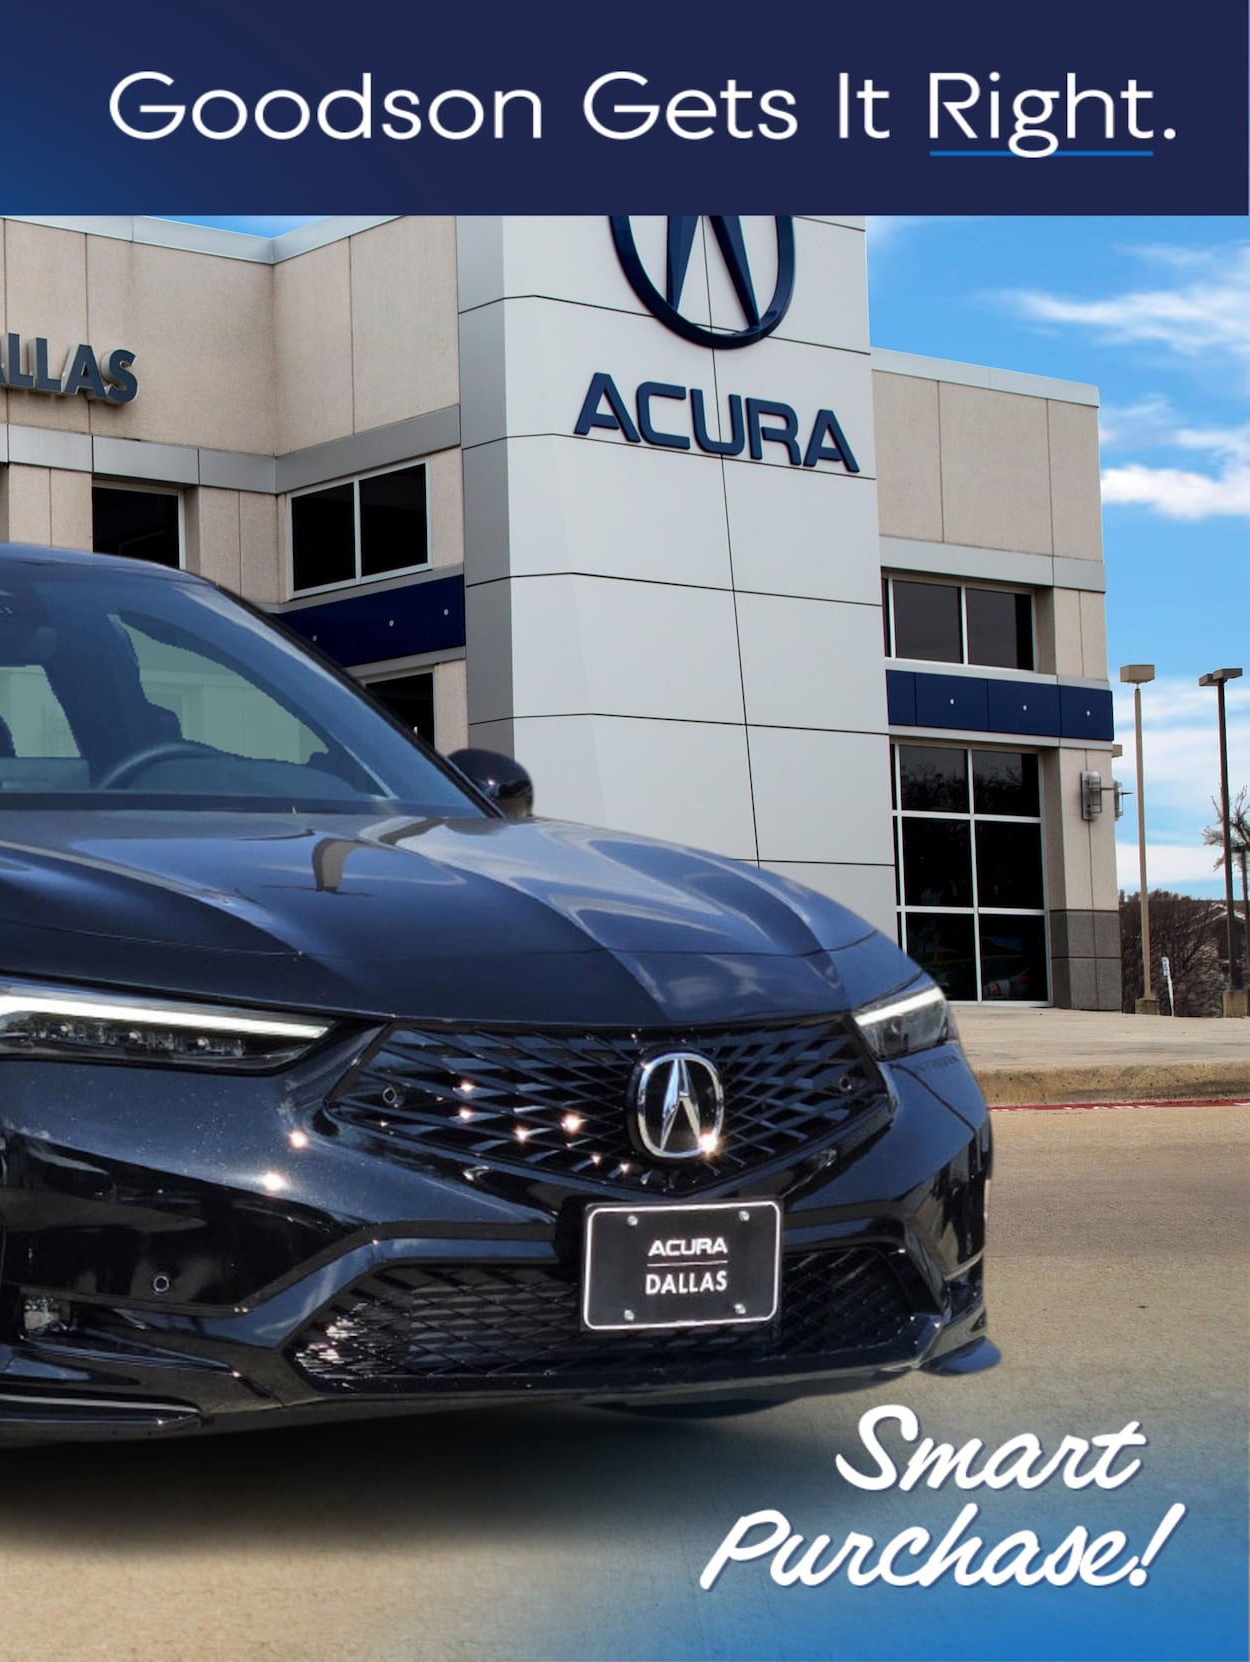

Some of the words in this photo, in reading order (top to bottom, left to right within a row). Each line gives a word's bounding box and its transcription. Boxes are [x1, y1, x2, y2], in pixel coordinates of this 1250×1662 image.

[573, 371, 861, 473] ACURA
[647, 1237, 728, 1257] ACURA
[645, 1270, 728, 1295] DALLAS
